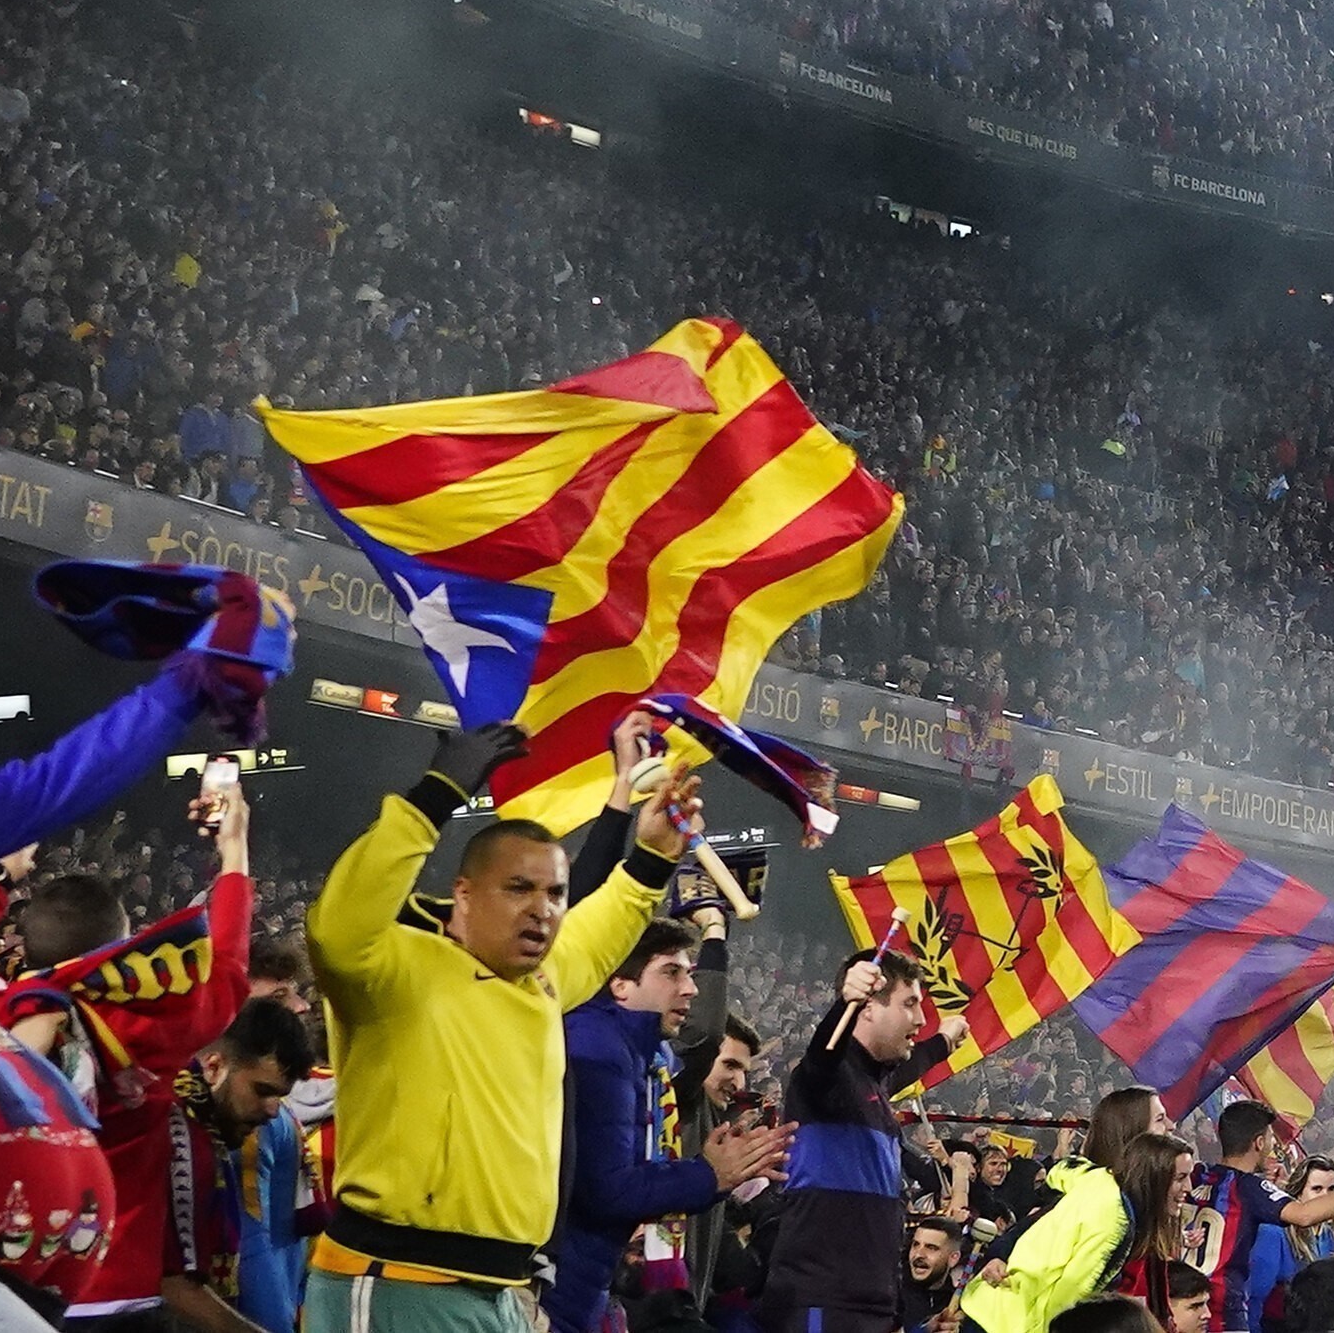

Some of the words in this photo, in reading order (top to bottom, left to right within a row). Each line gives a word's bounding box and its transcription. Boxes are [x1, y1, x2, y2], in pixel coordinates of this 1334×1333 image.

[799, 61, 817, 80] FC
[818, 68, 893, 105] BARCELONA
[996, 125, 1023, 145] QUE
[1045, 138, 1077, 160] CLUB
[1173, 173, 1191, 188] FC
[1191, 177, 1267, 207] BARCELONA
[1105, 763, 1157, 802] ESTIL
